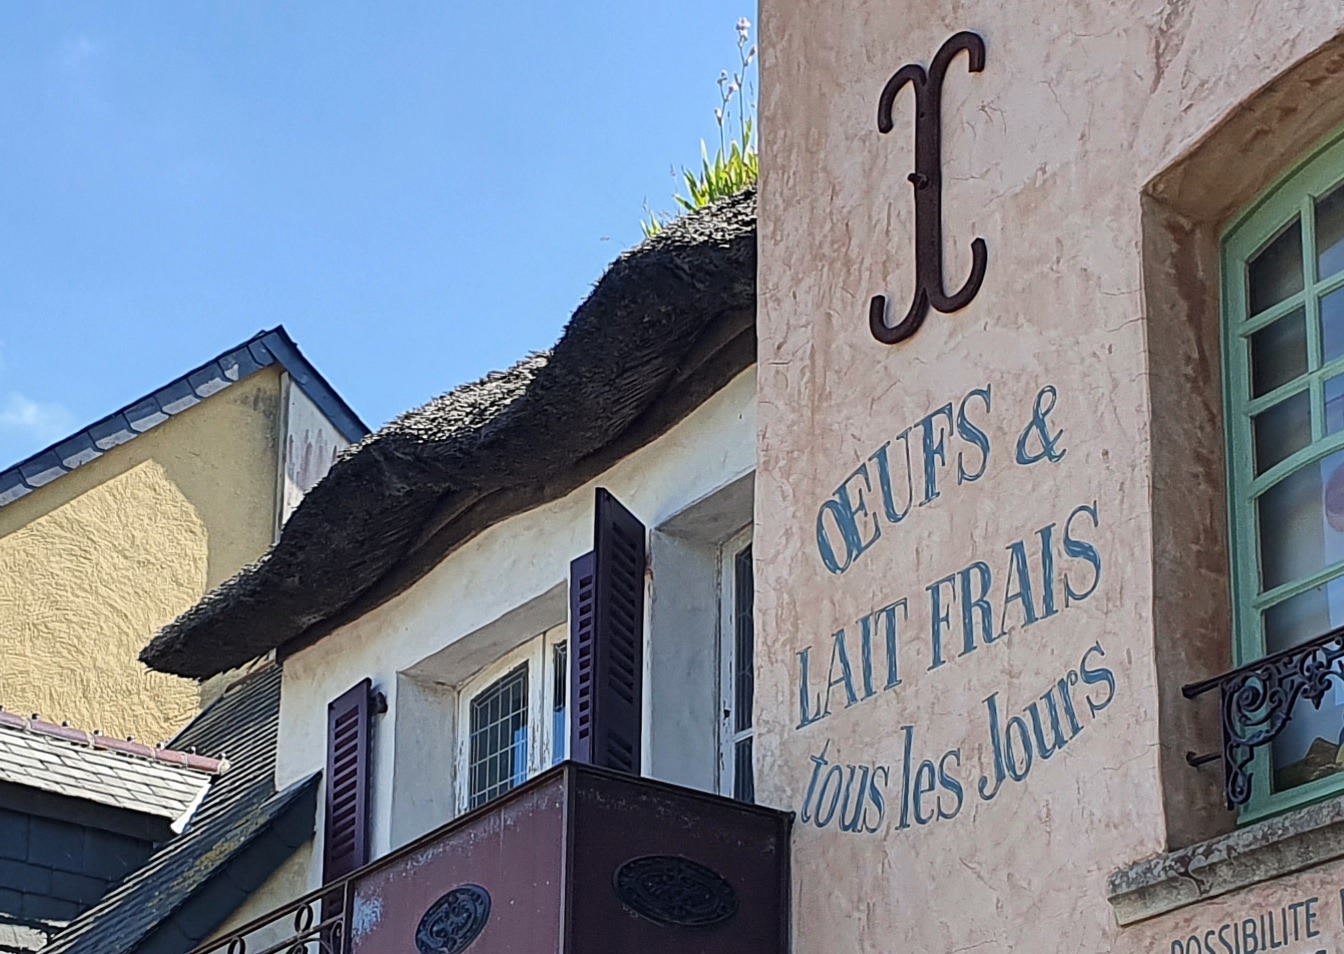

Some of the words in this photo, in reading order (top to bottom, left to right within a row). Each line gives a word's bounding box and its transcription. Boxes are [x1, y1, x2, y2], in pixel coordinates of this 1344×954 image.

[1015, 384, 1067, 465] &
[796, 596, 909, 730] LAIT
[925, 500, 1101, 673] FRAIS
[800, 738, 891, 834] tous
[894, 725, 964, 831] les
[978, 640, 1116, 801] Jours
